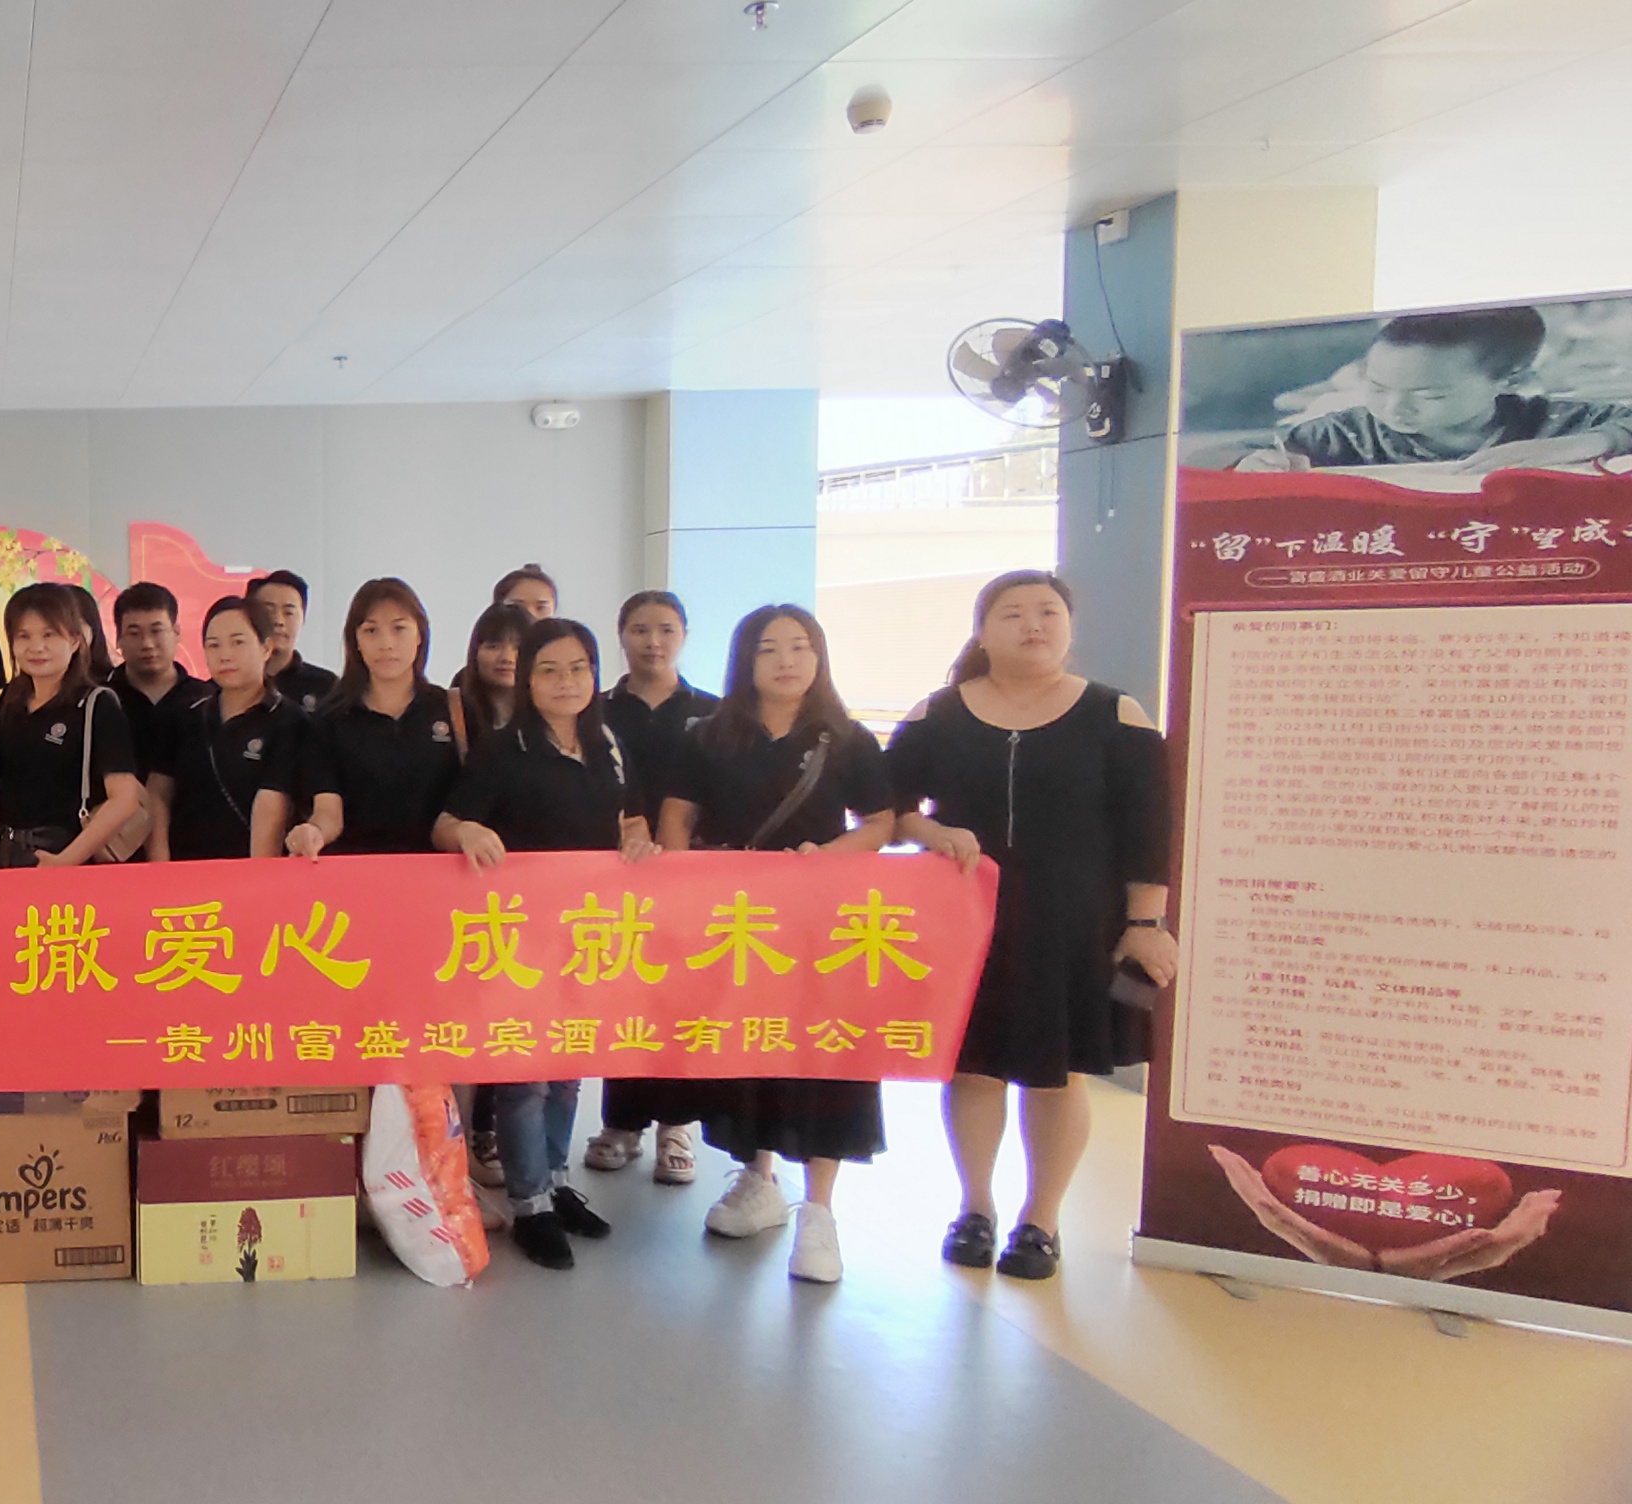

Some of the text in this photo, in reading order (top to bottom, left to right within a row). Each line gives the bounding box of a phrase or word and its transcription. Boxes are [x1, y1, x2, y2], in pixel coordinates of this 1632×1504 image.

[435, 889, 932, 988] 成就未来
[175, 1114, 193, 1128] 12
